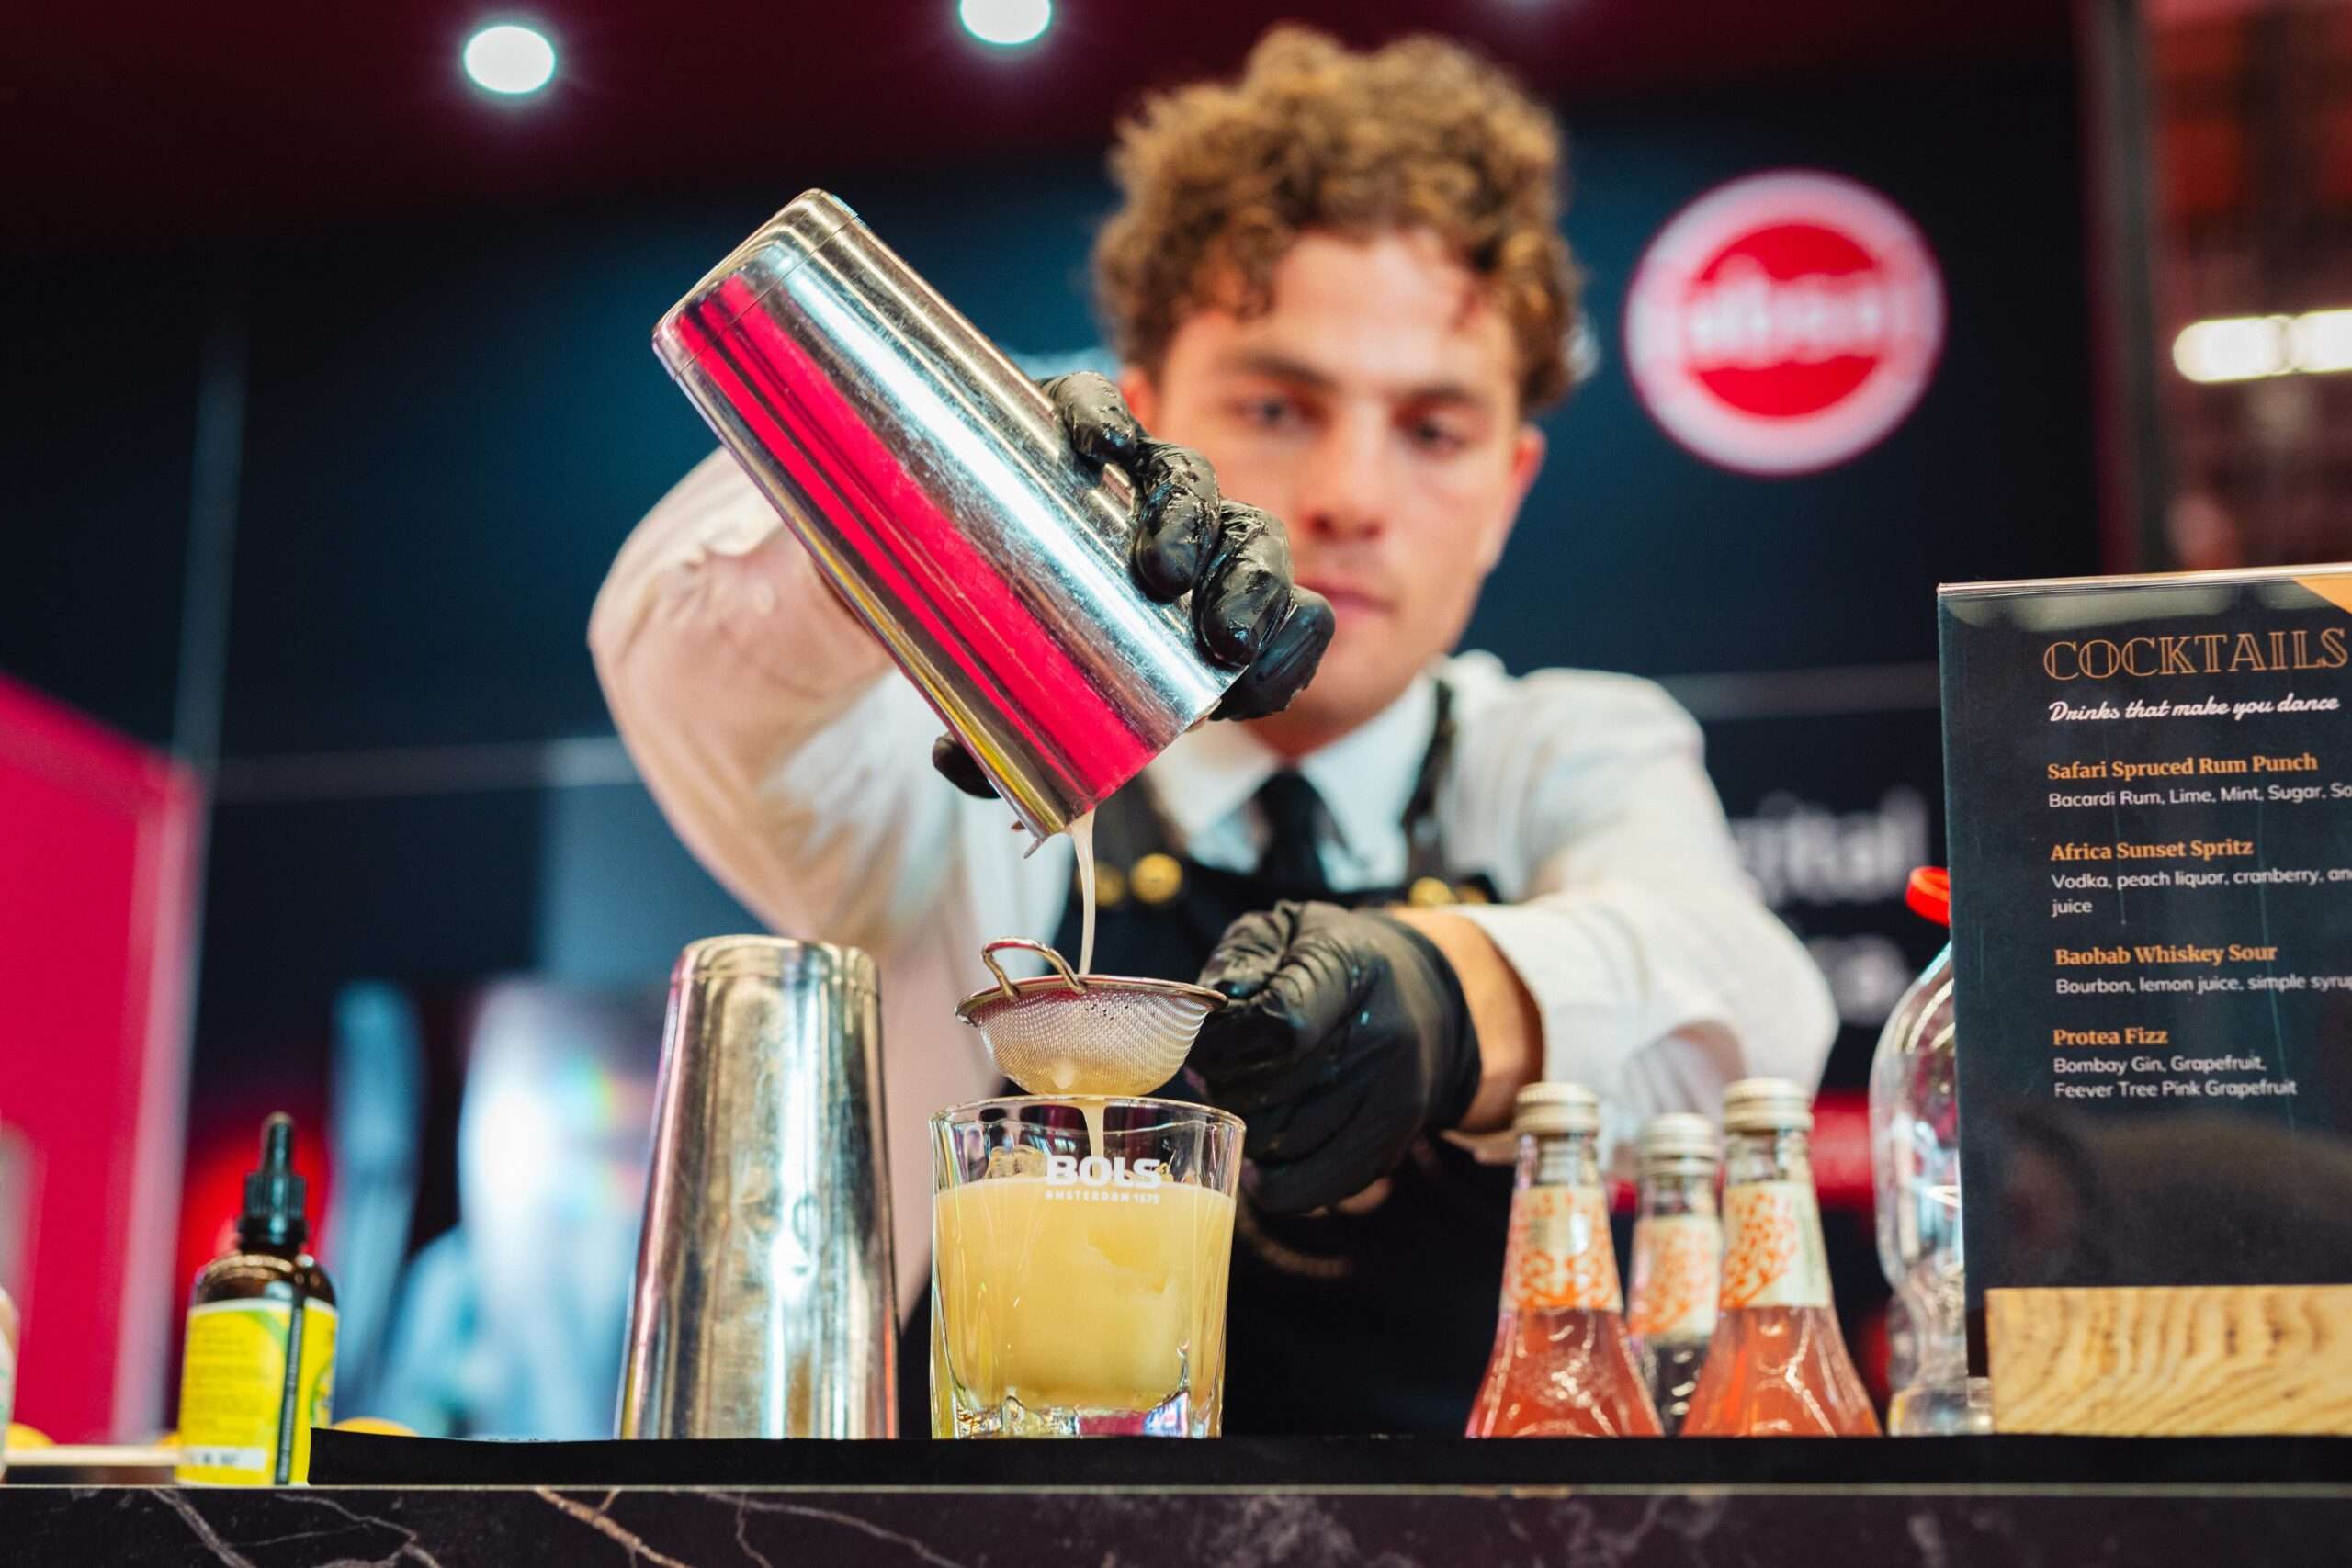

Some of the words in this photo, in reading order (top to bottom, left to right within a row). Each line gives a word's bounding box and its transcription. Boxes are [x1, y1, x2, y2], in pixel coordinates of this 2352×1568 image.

[2043, 627, 2348, 681] COCKTAILS
[2048, 701, 2120, 722] Drinks
[2124, 698, 2171, 719] that
[2171, 695, 2231, 716] make
[2232, 701, 2275, 721] you
[2276, 692, 2340, 712] dance
[2047, 761, 2108, 780] Safari
[2111, 756, 2195, 782] Spruced
[2199, 757, 2248, 774] Rum
[2252, 752, 2319, 773] Punch
[2049, 791, 2115, 808] Bacardi
[2050, 842, 2112, 861] Africa
[2116, 840, 2188, 859] Sunset
[2189, 837, 2255, 862] Spritz
[2117, 871, 2171, 891] peach
[2051, 899, 2094, 918] juice
[2054, 946, 2132, 965] Baobab
[2133, 944, 2224, 965] Whiskey
[2227, 943, 2278, 962] Sour
[2139, 976, 2195, 993] lemon
[2246, 974, 2307, 993] simple
[2052, 1028, 2121, 1046] Protea
[2123, 1026, 2169, 1045] Fizz
[2053, 1056, 2128, 1077] Bombay
[2053, 1081, 2115, 1099] Feever
[2117, 1080, 2159, 1098] Tree
[2161, 1079, 2201, 1097] Pink
[2204, 1078, 2298, 1100] Grapefruit
[1046, 1155, 1162, 1189] BOLS
